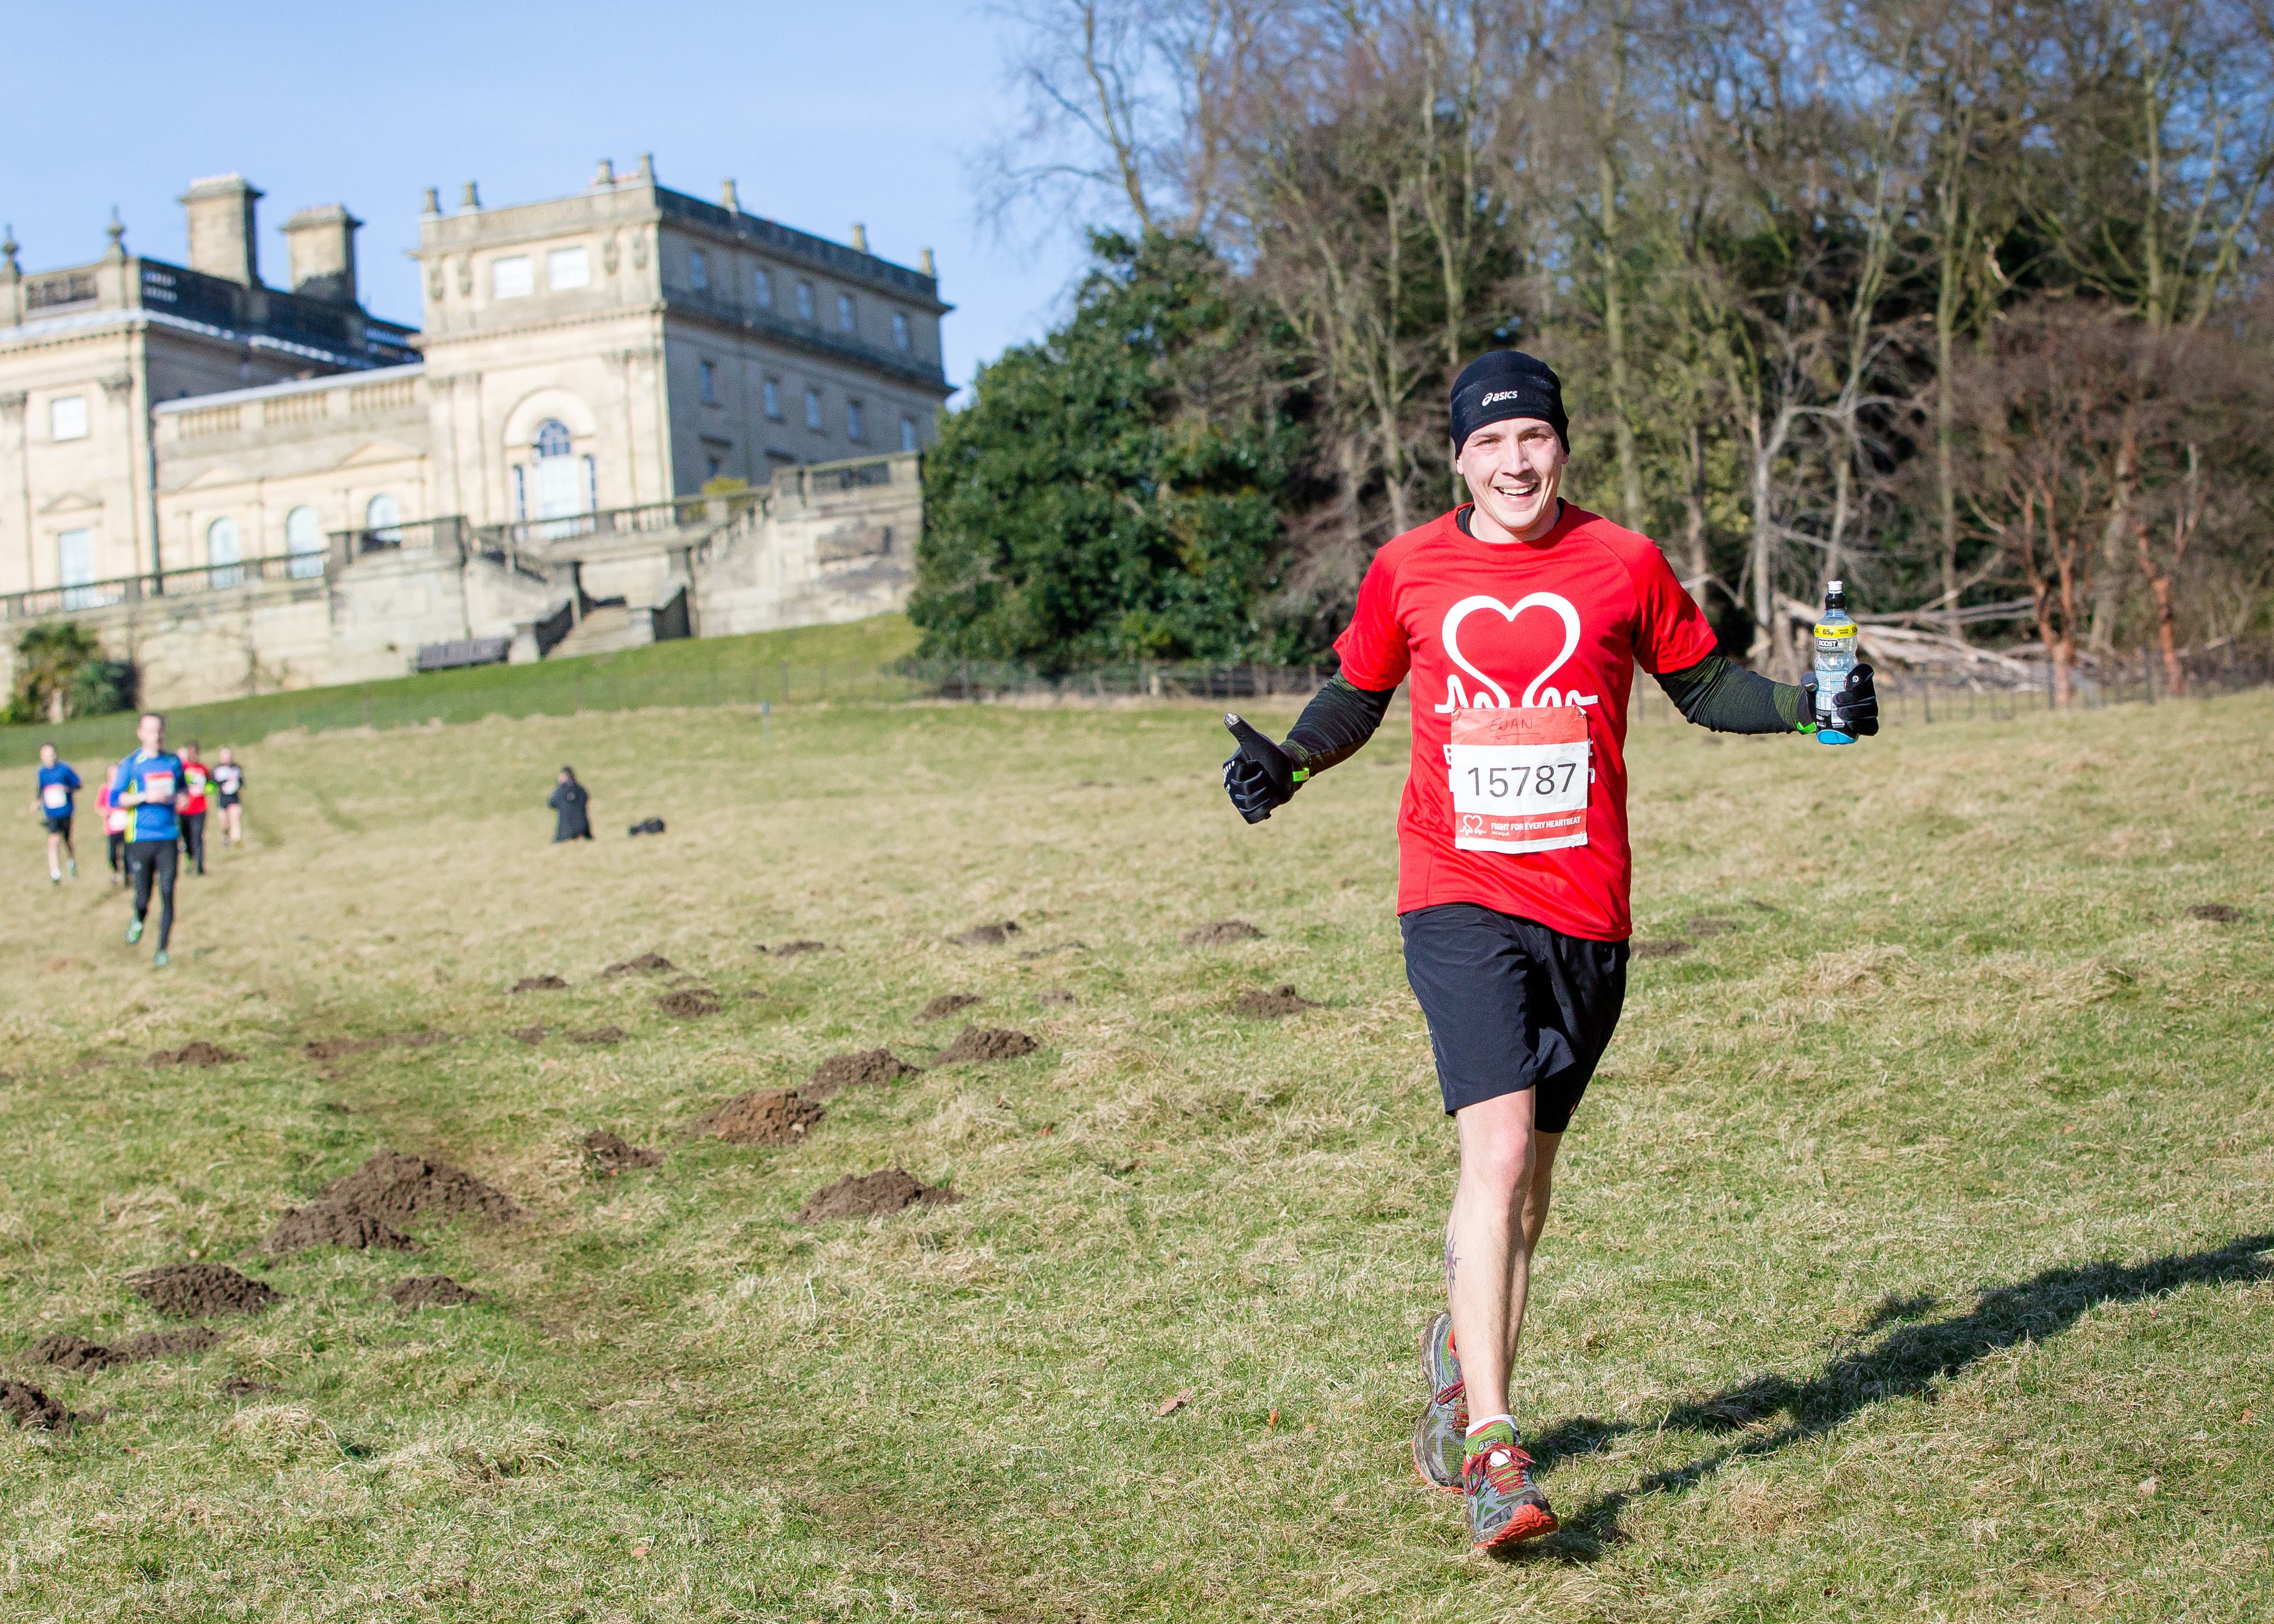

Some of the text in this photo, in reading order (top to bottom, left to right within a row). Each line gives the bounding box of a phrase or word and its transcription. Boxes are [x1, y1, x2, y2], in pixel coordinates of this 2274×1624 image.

[1468, 763, 1576, 798] 15787
[1491, 816, 1582, 832] FIGHT FOR EVERY HEARTBEAT
